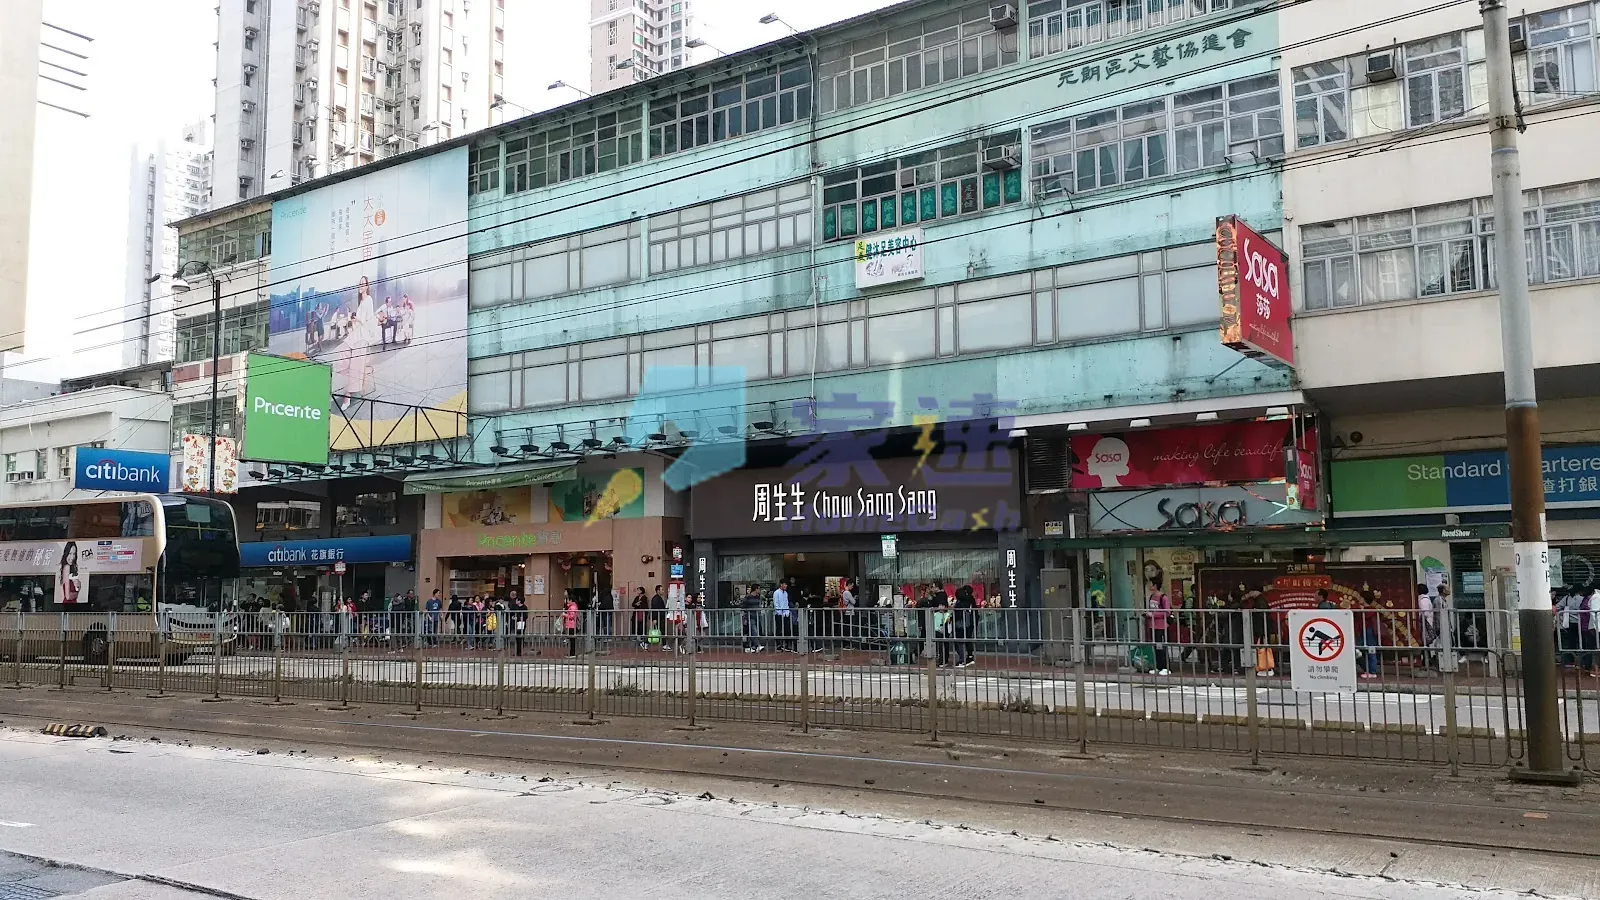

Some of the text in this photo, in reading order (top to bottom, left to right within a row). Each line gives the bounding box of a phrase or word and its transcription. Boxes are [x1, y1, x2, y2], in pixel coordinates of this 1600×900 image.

[1057, 28, 1252, 88] 元朗區文藝協進會
[1256, 293, 1270, 319] 莎莎
[254, 396, 321, 420] Pricerite
[1153, 438, 1294, 467] making life beautif
[85, 462, 160, 483] citibank
[1407, 456, 1600, 480] Standard artere
[752, 482, 936, 521] 周生生 Chow Sang Sang
[1441, 529, 1471, 538] RoadShow
[81, 547, 93, 558] FDA
[268, 546, 344, 562] citibank 花旗銀行
[1006, 549, 1018, 608] 周生生
